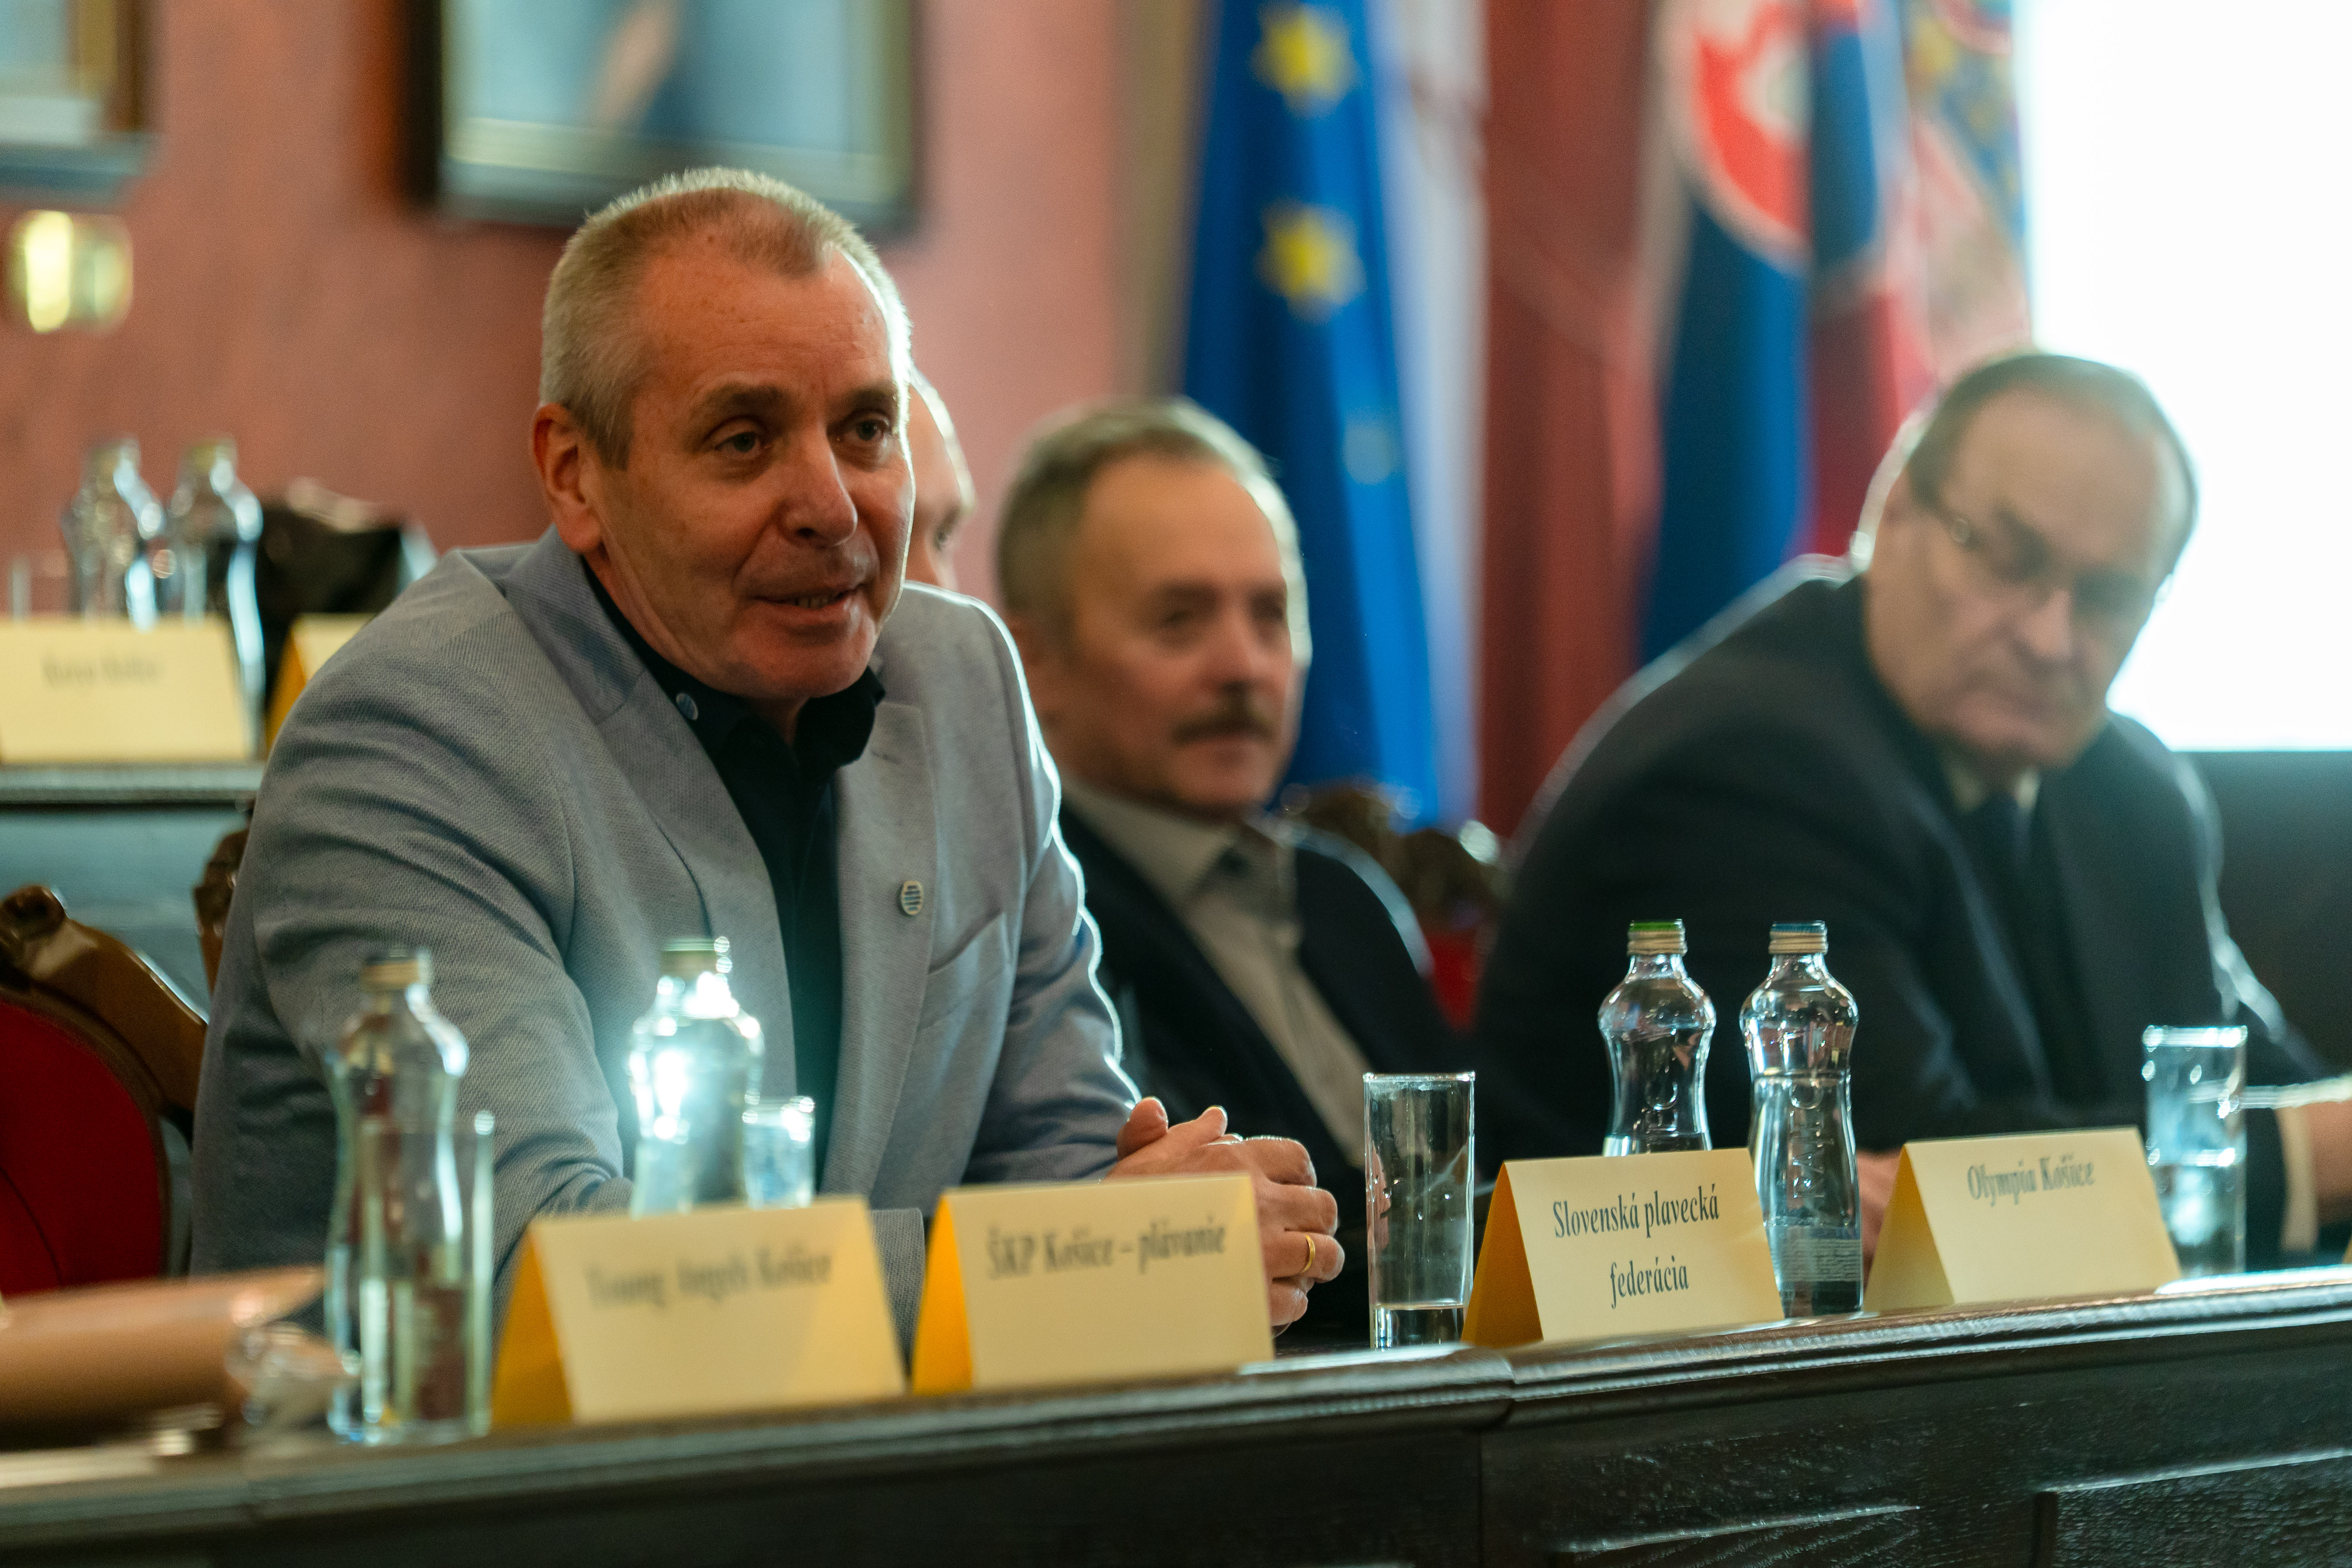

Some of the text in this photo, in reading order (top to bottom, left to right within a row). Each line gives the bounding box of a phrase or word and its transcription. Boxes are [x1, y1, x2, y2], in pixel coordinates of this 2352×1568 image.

[2040, 1154, 2096, 1191] Košice
[1552, 1183, 1720, 1238] Slovenská plavecká
[1610, 1255, 1689, 1310] federácia
